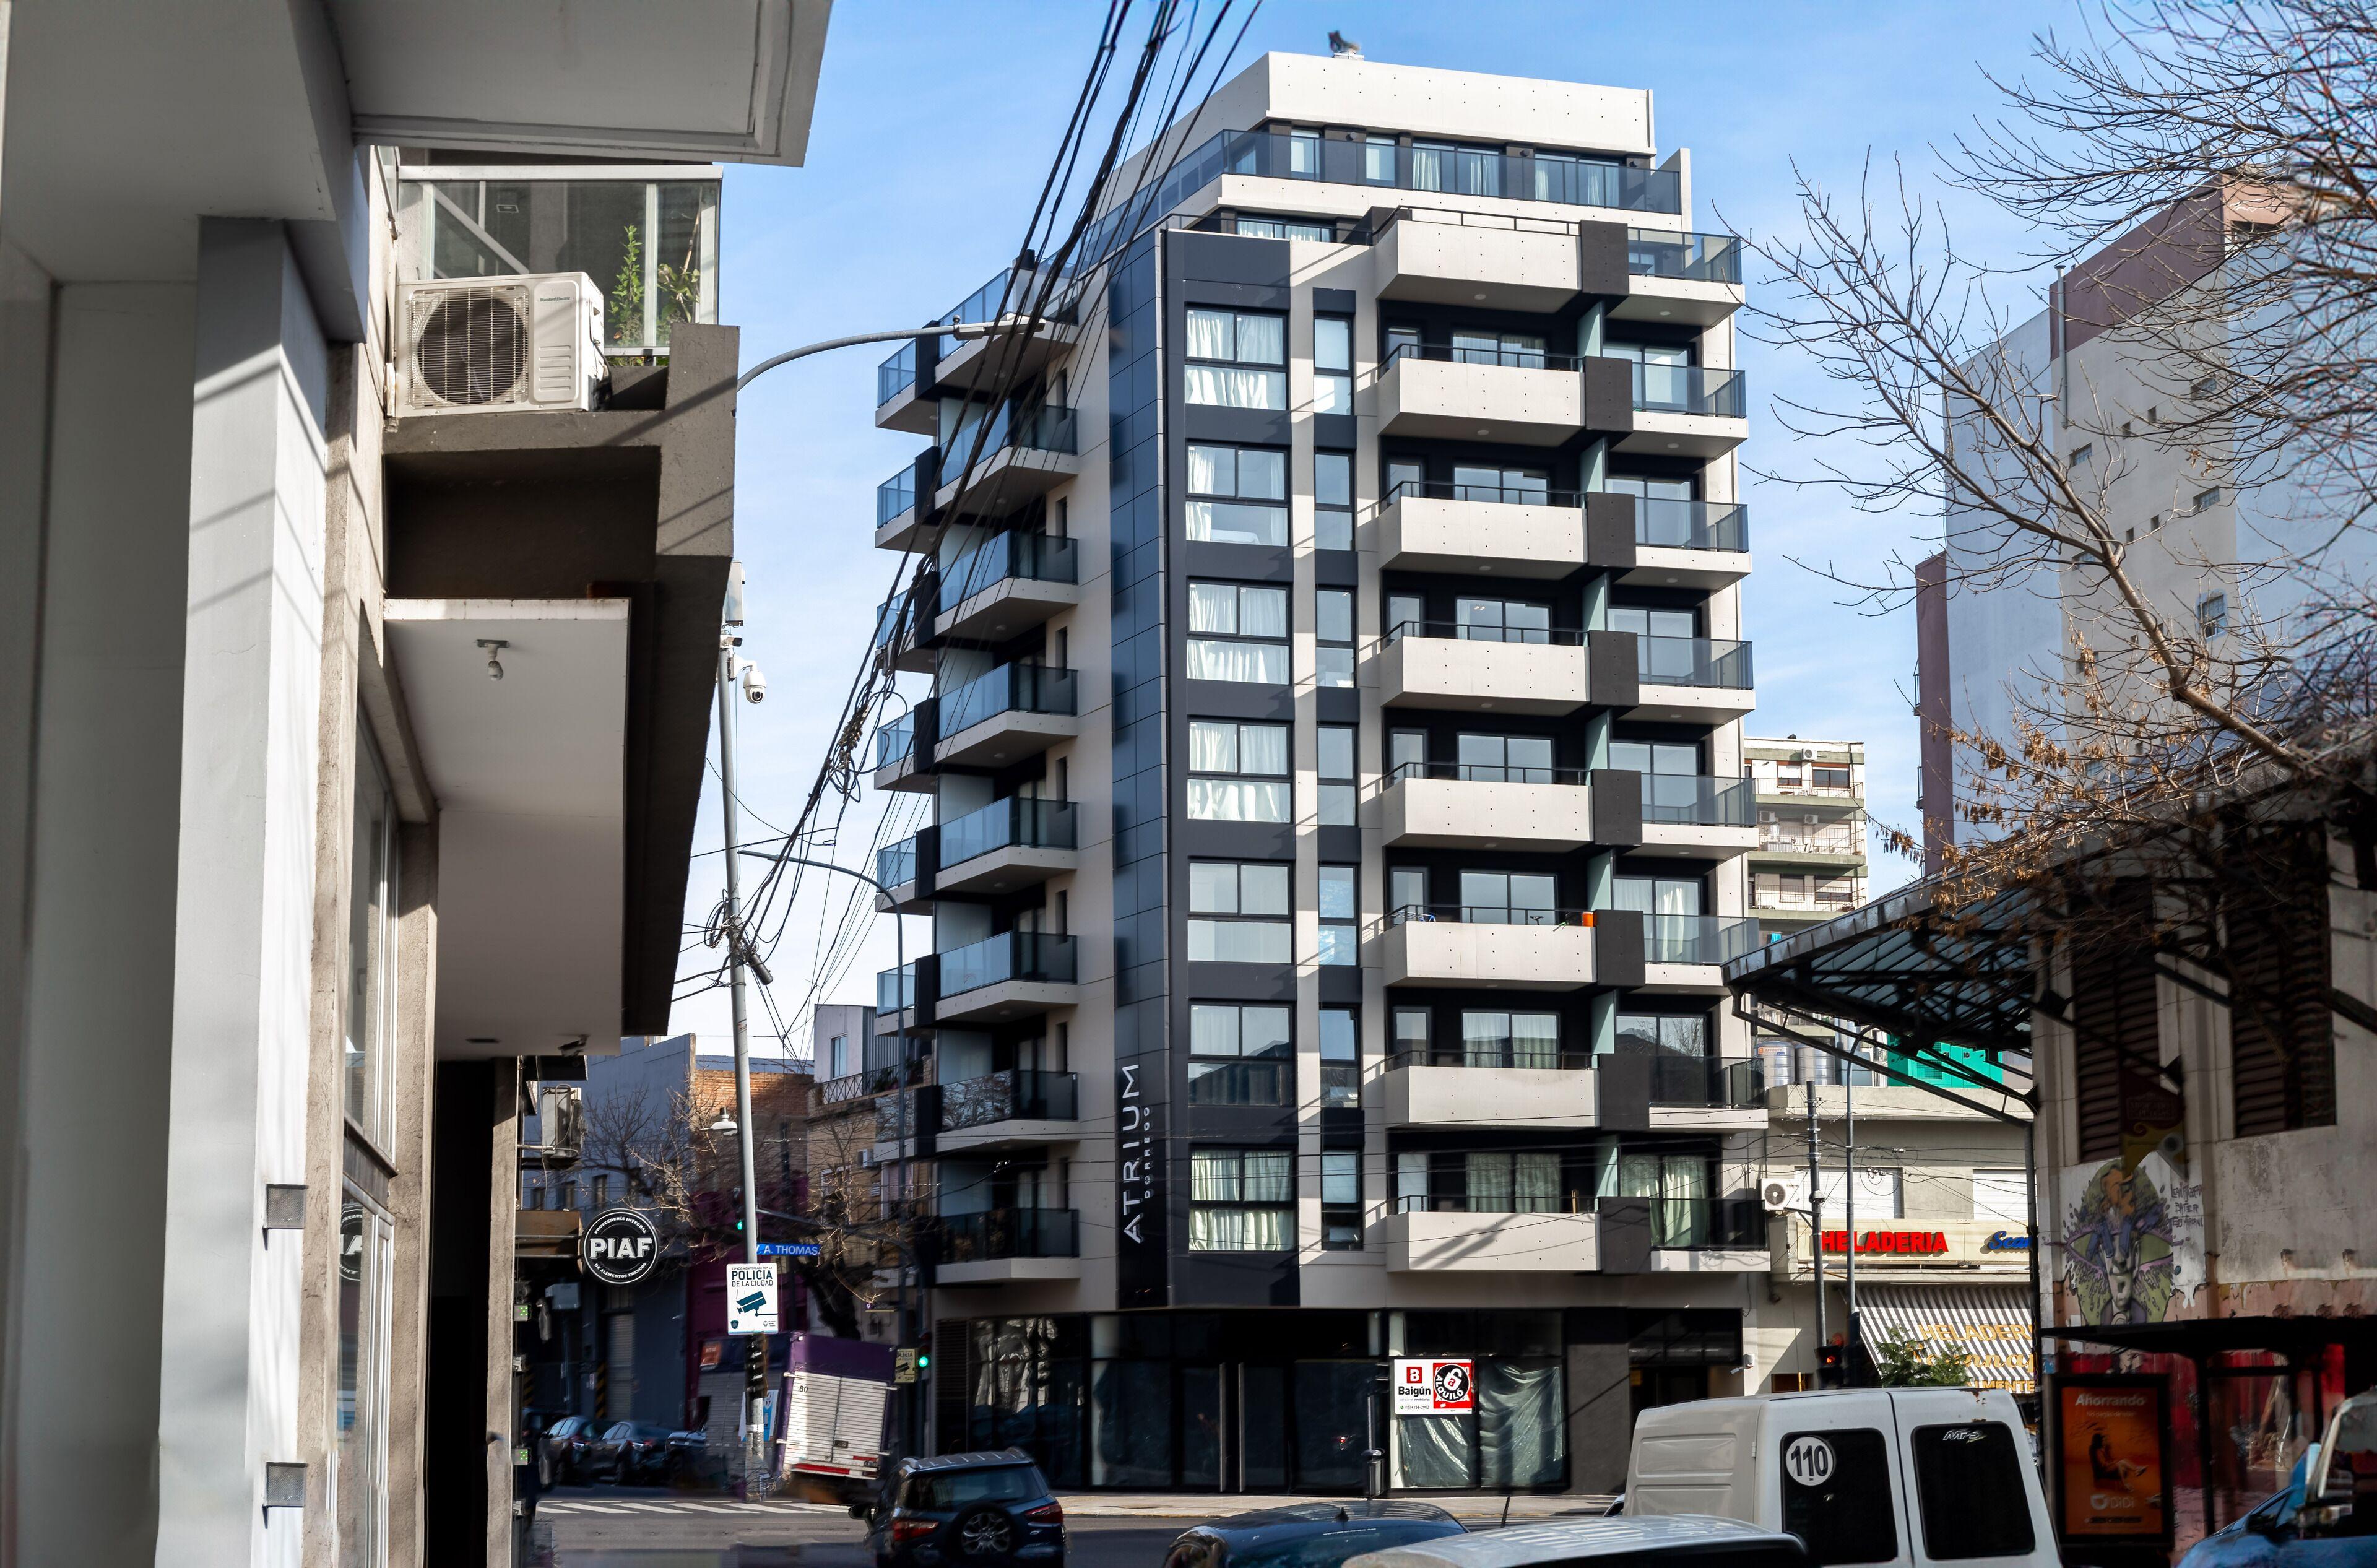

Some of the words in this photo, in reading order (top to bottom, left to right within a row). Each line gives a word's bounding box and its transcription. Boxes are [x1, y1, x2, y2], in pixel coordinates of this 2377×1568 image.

[1122, 1064, 1142, 1244] ATRIUM
[626, 1217, 647, 1234] INTEGRAL
[589, 1237, 652, 1260] PIAF
[764, 1245, 773, 1254] A.
[776, 1245, 818, 1255] THOMAS
[1821, 1231, 1949, 1252] HELADERIA
[600, 1267, 628, 1278] ALIMENTOS
[628, 1263, 647, 1277] FRESCOS
[732, 1270, 773, 1280] POLICIA
[1918, 1324, 2033, 1341] HELADER
[1398, 1386, 1431, 1397] Baigún
[1435, 1374, 1464, 1400] ALQUILÓ
[2075, 1393, 2146, 1406] Ahorrando
[1791, 1445, 1829, 1476] 110
[2110, 1496, 2135, 1509] DiDi
